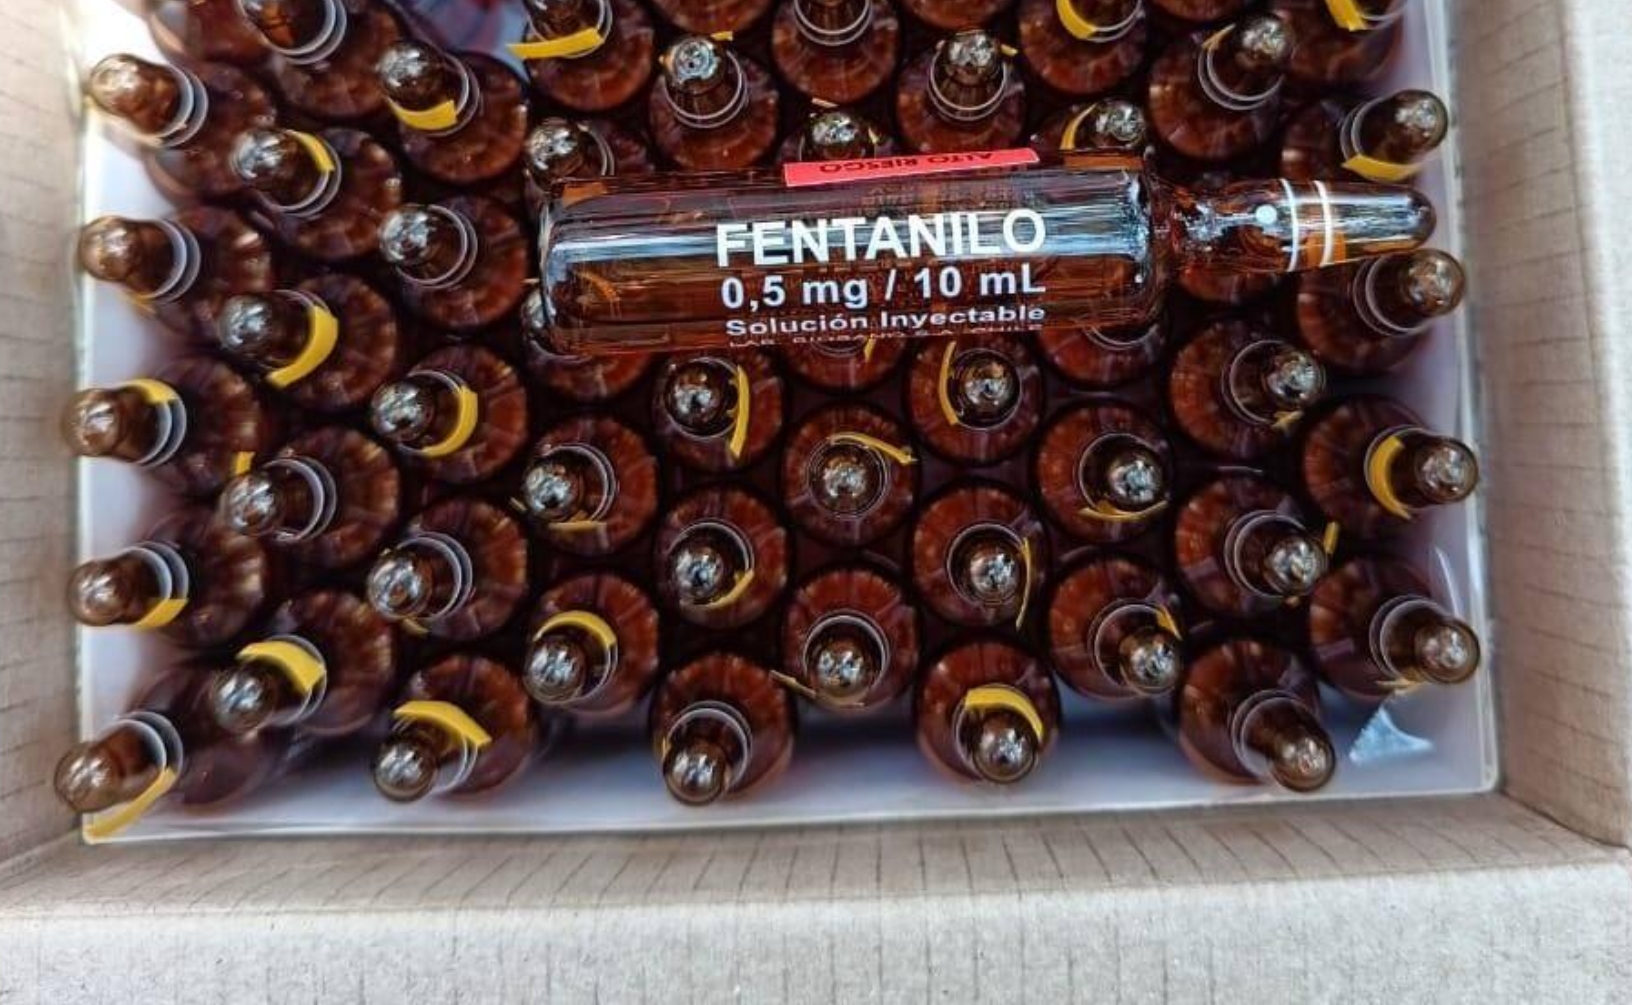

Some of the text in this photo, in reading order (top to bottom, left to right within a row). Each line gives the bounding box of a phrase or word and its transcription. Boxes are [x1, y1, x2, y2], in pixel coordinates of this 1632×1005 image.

[819, 152, 992, 173] ALTO RIESGO
[716, 208, 1047, 267] FENTANILO
[721, 262, 1046, 313] 0,5 mg / 10 mL
[725, 304, 1046, 336] Solución Inyectable
